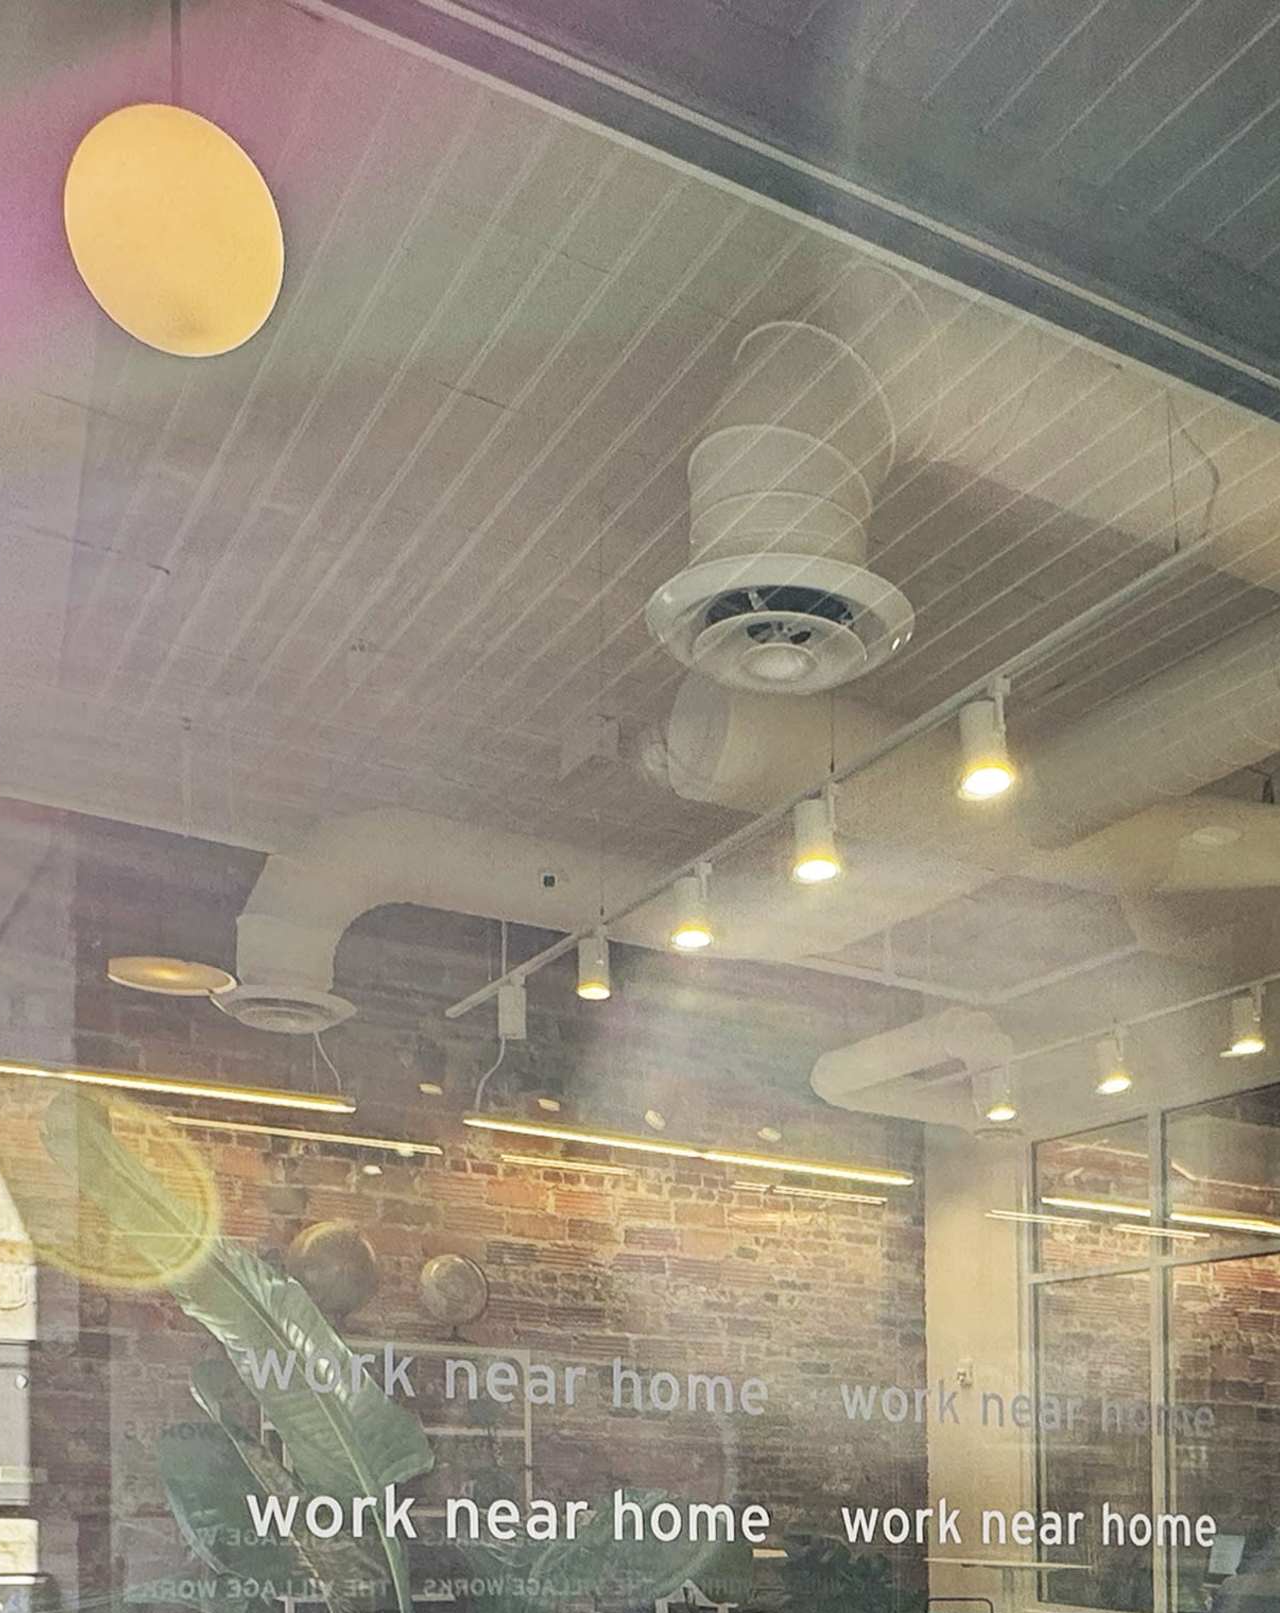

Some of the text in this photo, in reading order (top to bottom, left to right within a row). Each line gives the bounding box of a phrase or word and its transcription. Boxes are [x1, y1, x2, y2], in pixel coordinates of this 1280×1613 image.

[246, 1342, 768, 1416] work near home
[841, 1380, 1215, 1436] work near home
[246, 1484, 771, 1543] work near home
[842, 1498, 1217, 1547] work near home
